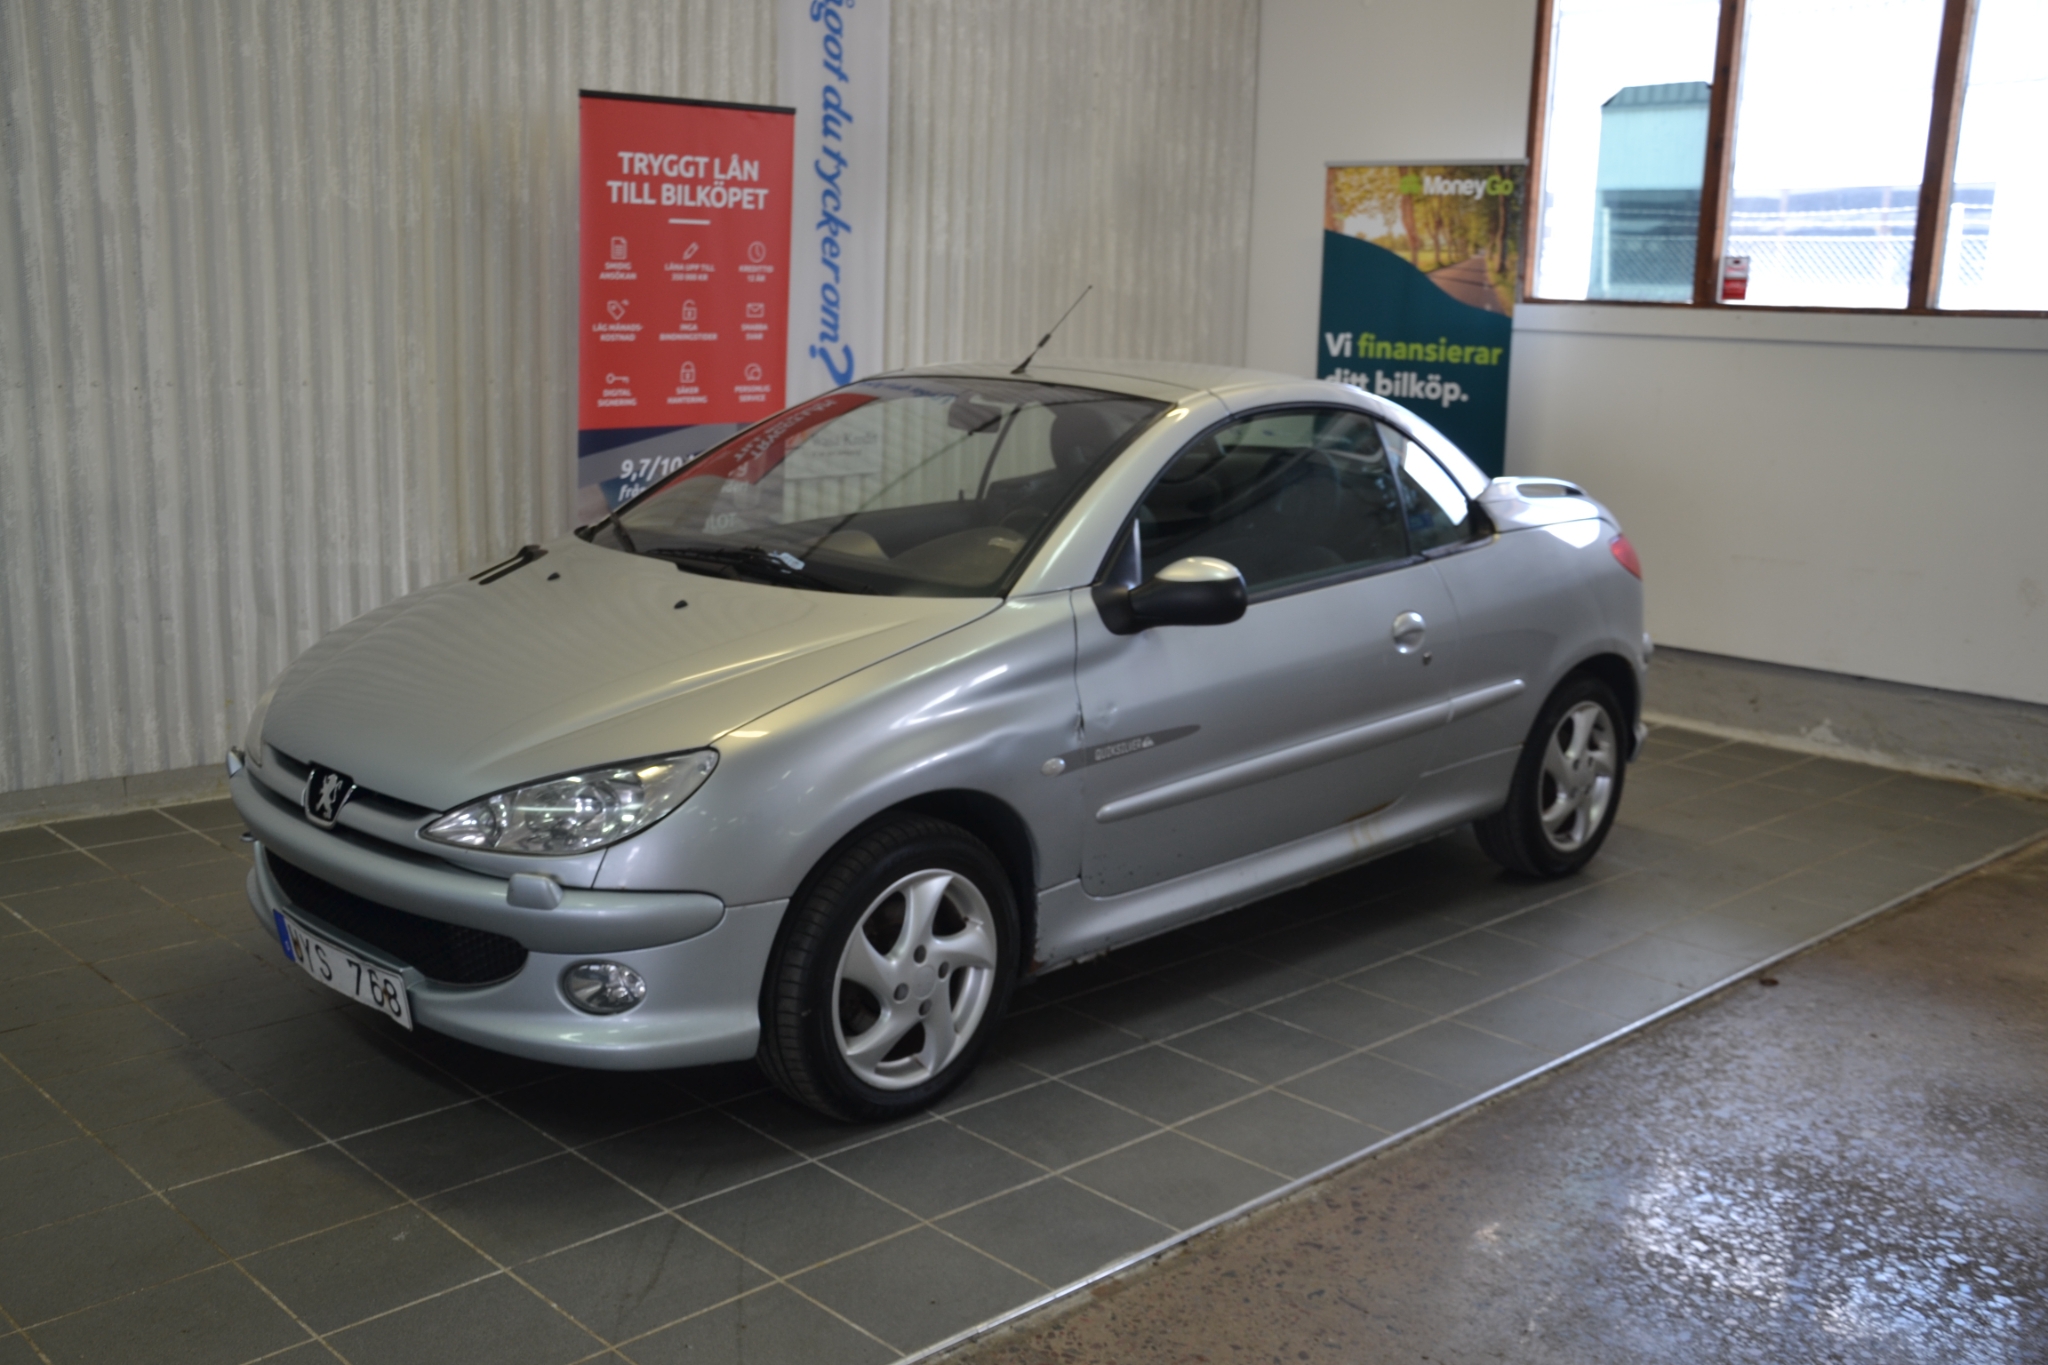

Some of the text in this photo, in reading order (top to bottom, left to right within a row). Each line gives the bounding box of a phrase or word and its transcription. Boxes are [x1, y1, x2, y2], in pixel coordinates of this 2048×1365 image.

[809, 0, 855, 83] got
[822, 85, 854, 141] du
[617, 151, 759, 181] TRYGGT LÅN
[606, 181, 769, 210] TILL BILKÖPET
[1423, 175, 1514, 200] MoneyGo
[599, 271, 637, 280] ANSÖKAN
[592, 322, 607, 332] LÅG
[600, 333, 636, 342] KOSTNAD
[679, 323, 698, 331] INGA
[1325, 332, 1503, 365] Vi finansierar
[602, 389, 632, 397] DIGITAL
[676, 386, 699, 395] SÄKER
[739, 394, 766, 402] SERVICE
[1374, 370, 1470, 408] bilköp.
[620, 455, 683, 481] 9,7/10
[346, 959, 402, 1017] 768
